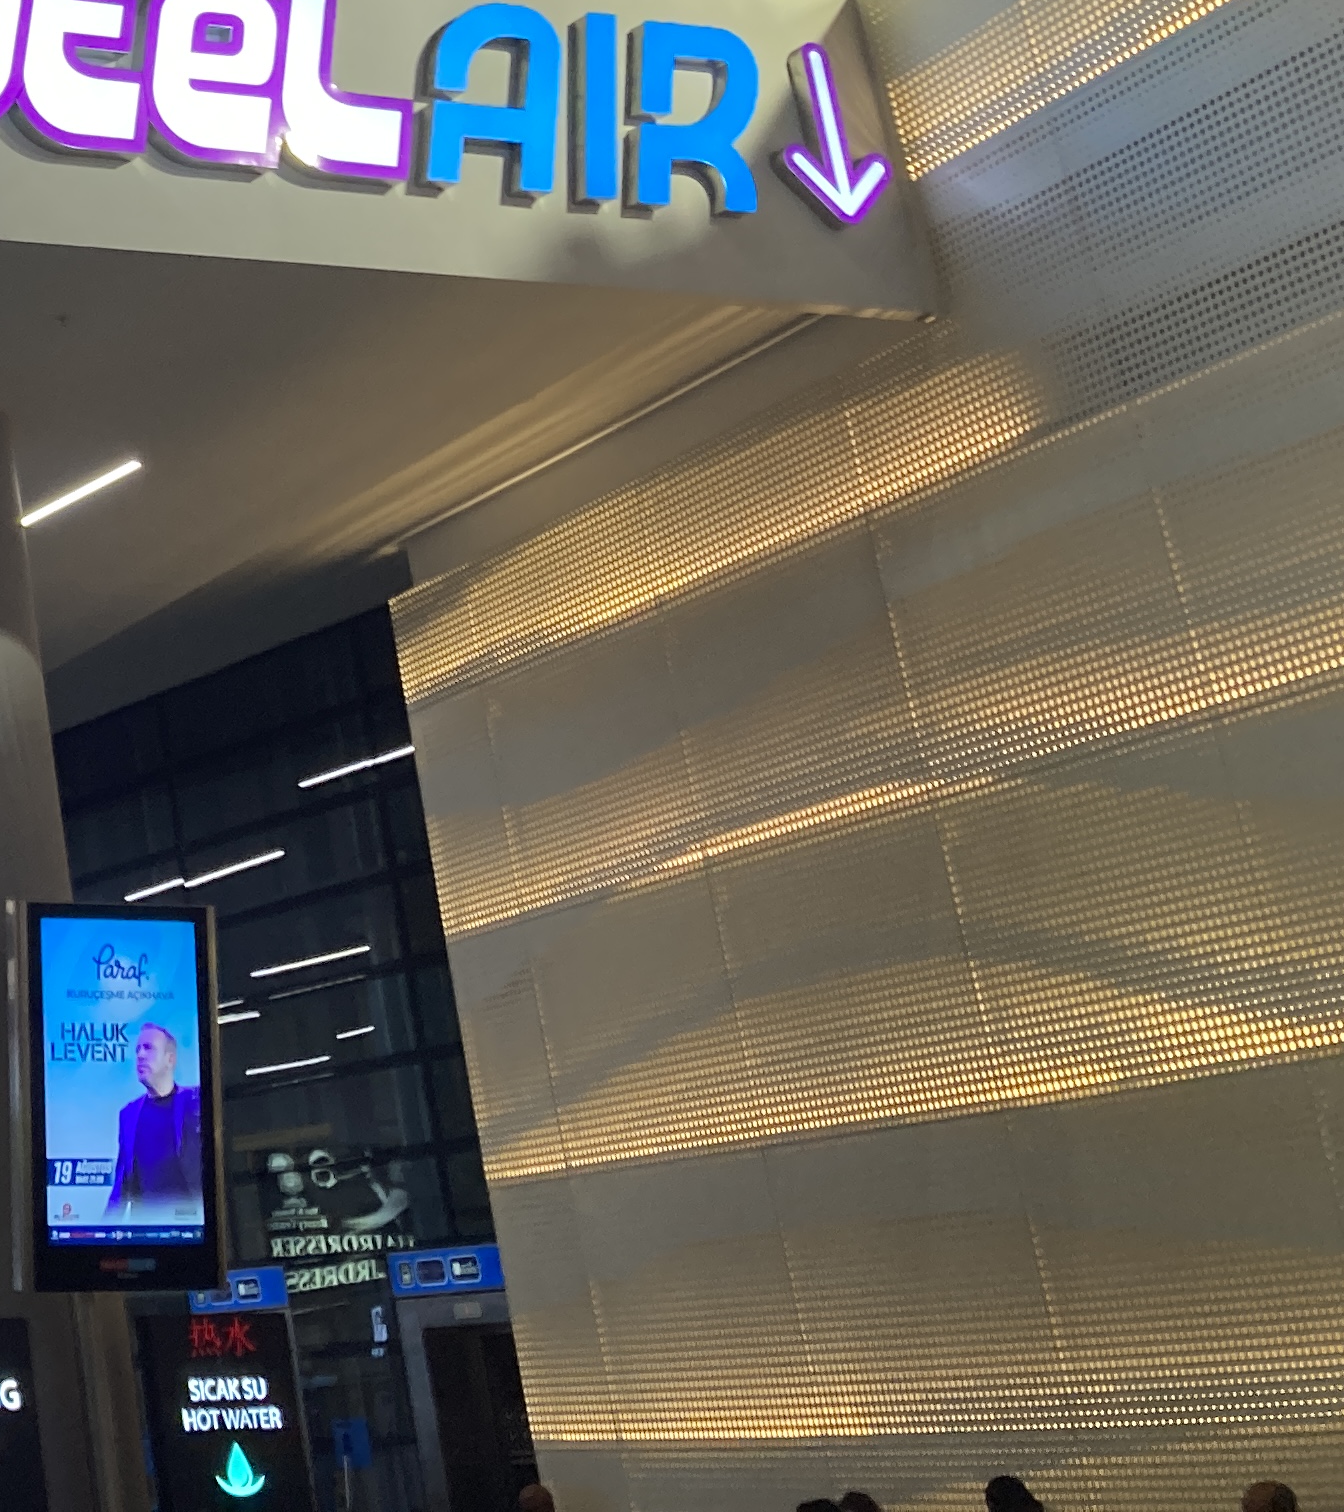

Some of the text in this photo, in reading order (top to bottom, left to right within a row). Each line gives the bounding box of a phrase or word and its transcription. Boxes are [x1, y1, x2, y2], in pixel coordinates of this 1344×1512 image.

[61, 1022, 129, 1043] HALUK
[50, 1042, 129, 1063] LEVENT
[54, 1161, 73, 1185] 19
[187, 1375, 269, 1402] SICAK SU
[181, 1404, 283, 1433] HOT WATER
